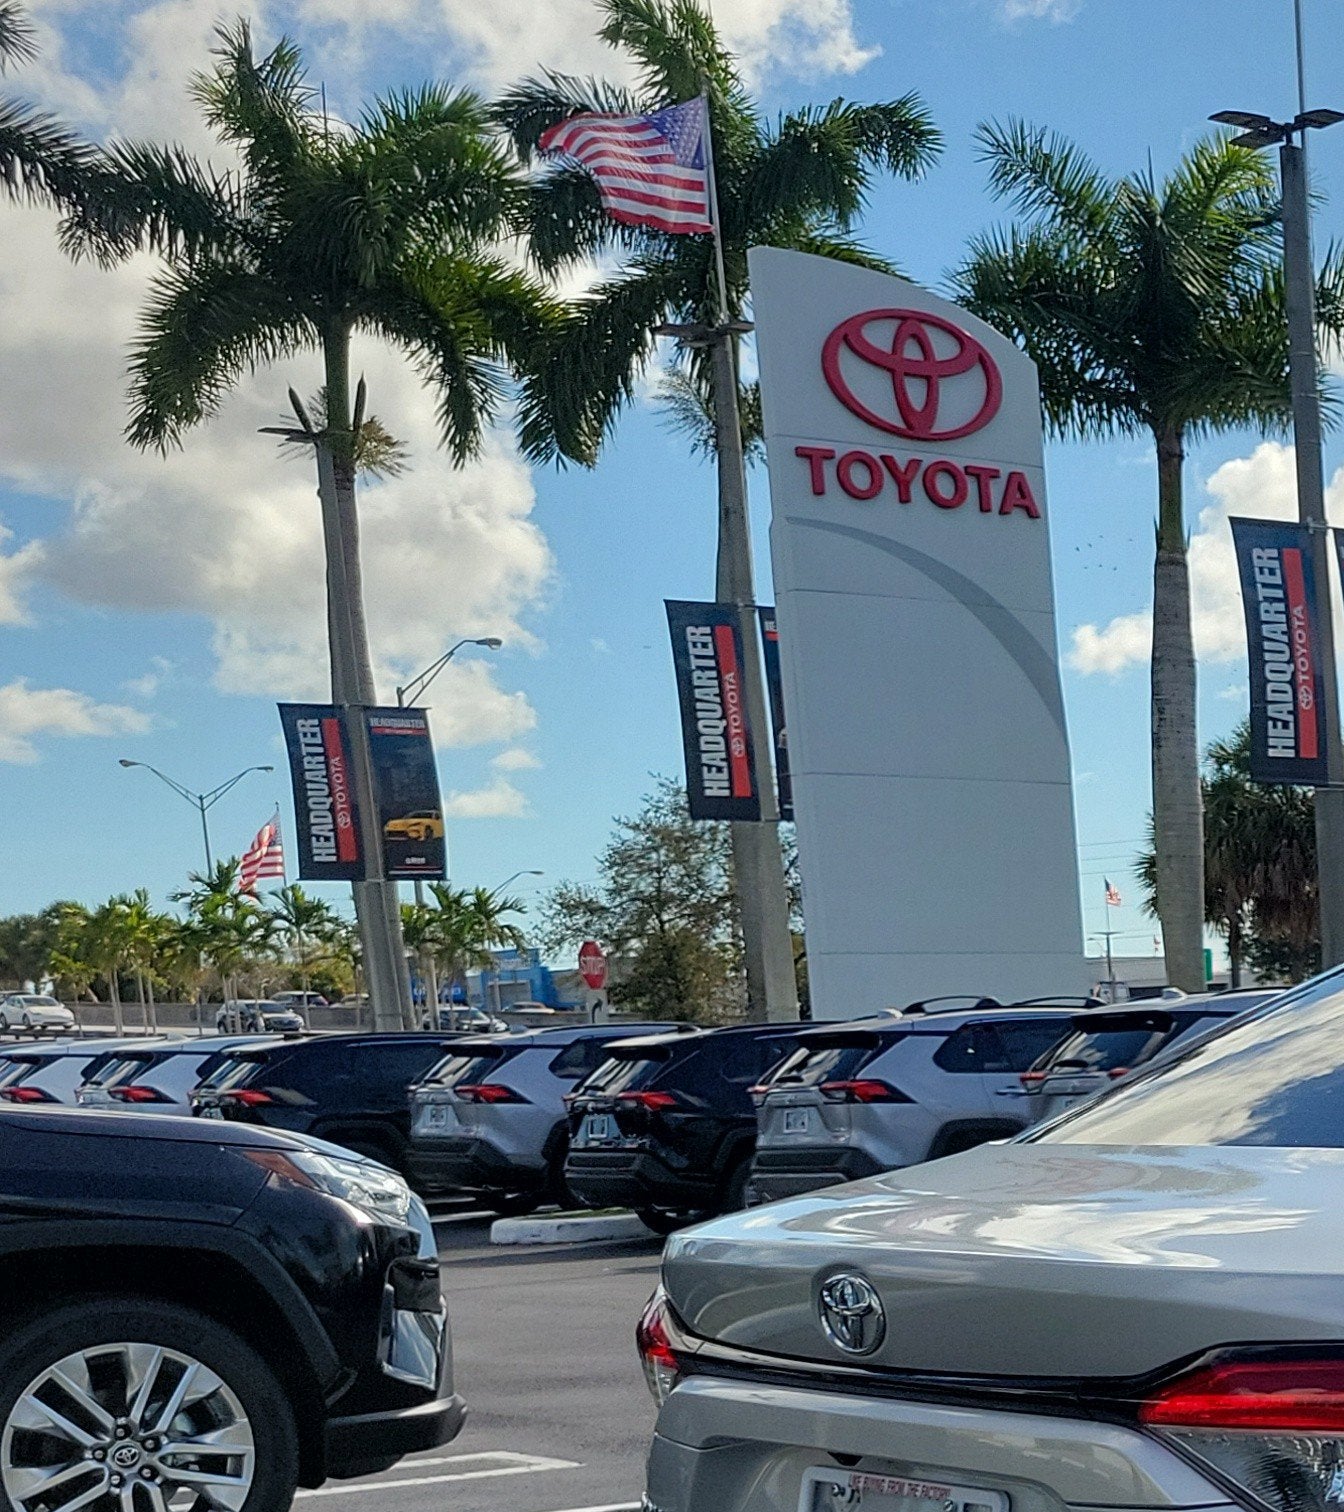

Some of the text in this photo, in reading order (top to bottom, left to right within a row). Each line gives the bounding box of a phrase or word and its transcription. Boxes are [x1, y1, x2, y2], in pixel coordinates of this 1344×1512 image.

[795, 446, 1040, 518] TOYOTA
[1252, 548, 1295, 758] HEADQUARTER
[1292, 605, 1311, 684] TOYOTA
[686, 625, 731, 798] HEADQUARTER
[724, 671, 744, 735] TOYOTA
[297, 718, 337, 863] HEADQUARTER
[330, 757, 352, 814] TOYOTA
